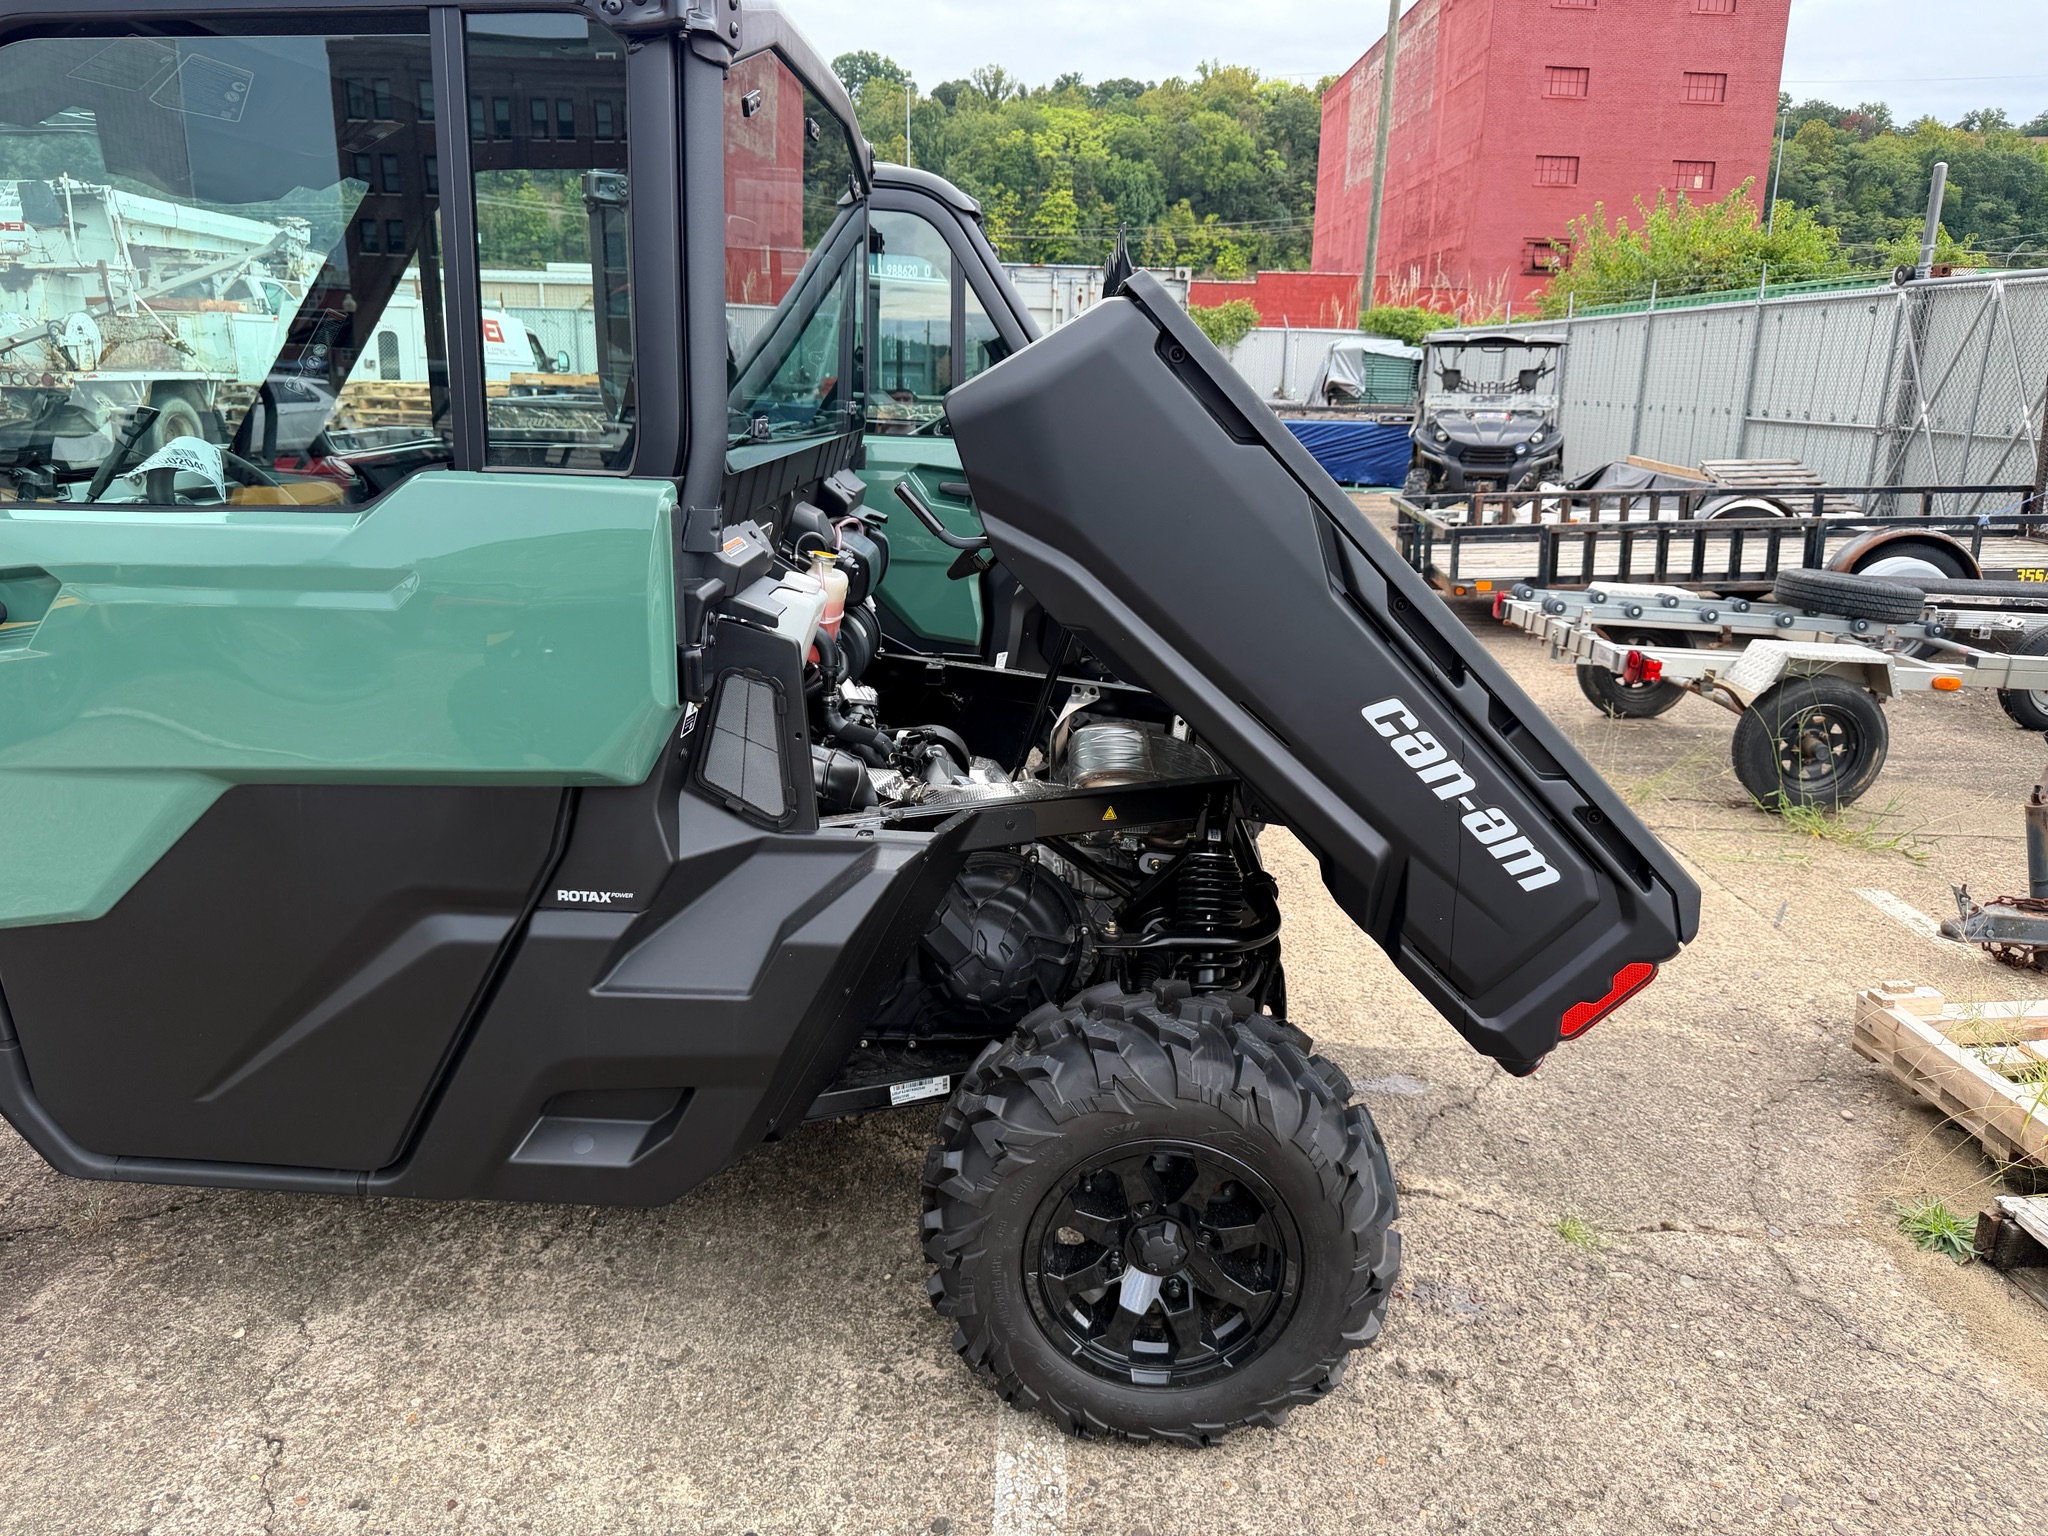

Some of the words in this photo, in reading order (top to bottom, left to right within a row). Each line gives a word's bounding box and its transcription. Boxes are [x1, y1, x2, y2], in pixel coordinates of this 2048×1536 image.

[886, 264, 918, 277] 988620
[1361, 698, 1561, 892] can-am
[557, 889, 612, 903] ROTAX
